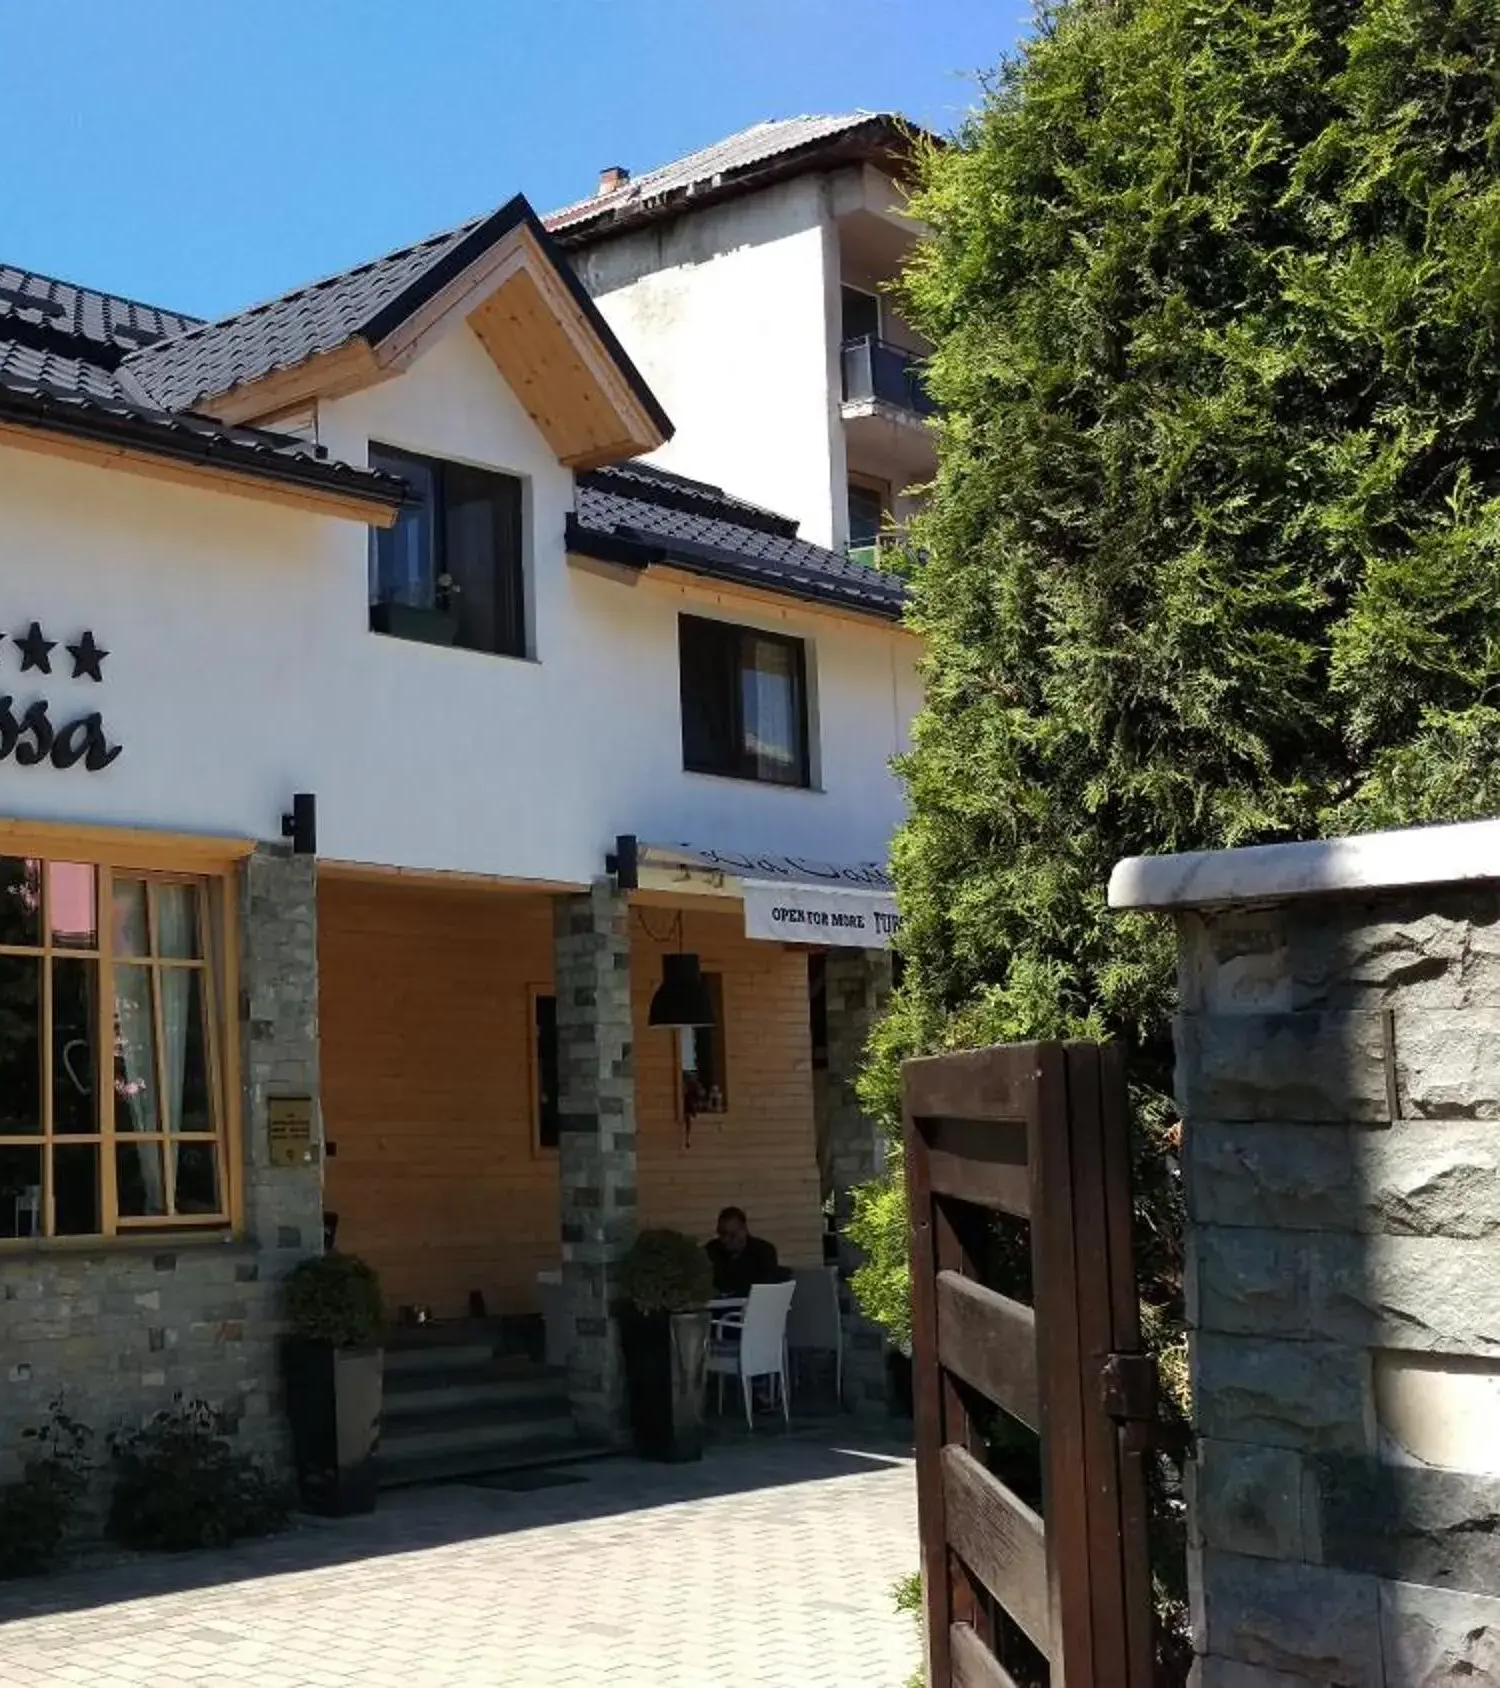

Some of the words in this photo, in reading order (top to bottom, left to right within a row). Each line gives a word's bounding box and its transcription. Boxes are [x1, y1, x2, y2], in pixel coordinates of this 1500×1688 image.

[771, 906, 805, 923] OPEN
[806, 911, 829, 926] FOR
[830, 913, 865, 929] MORE
